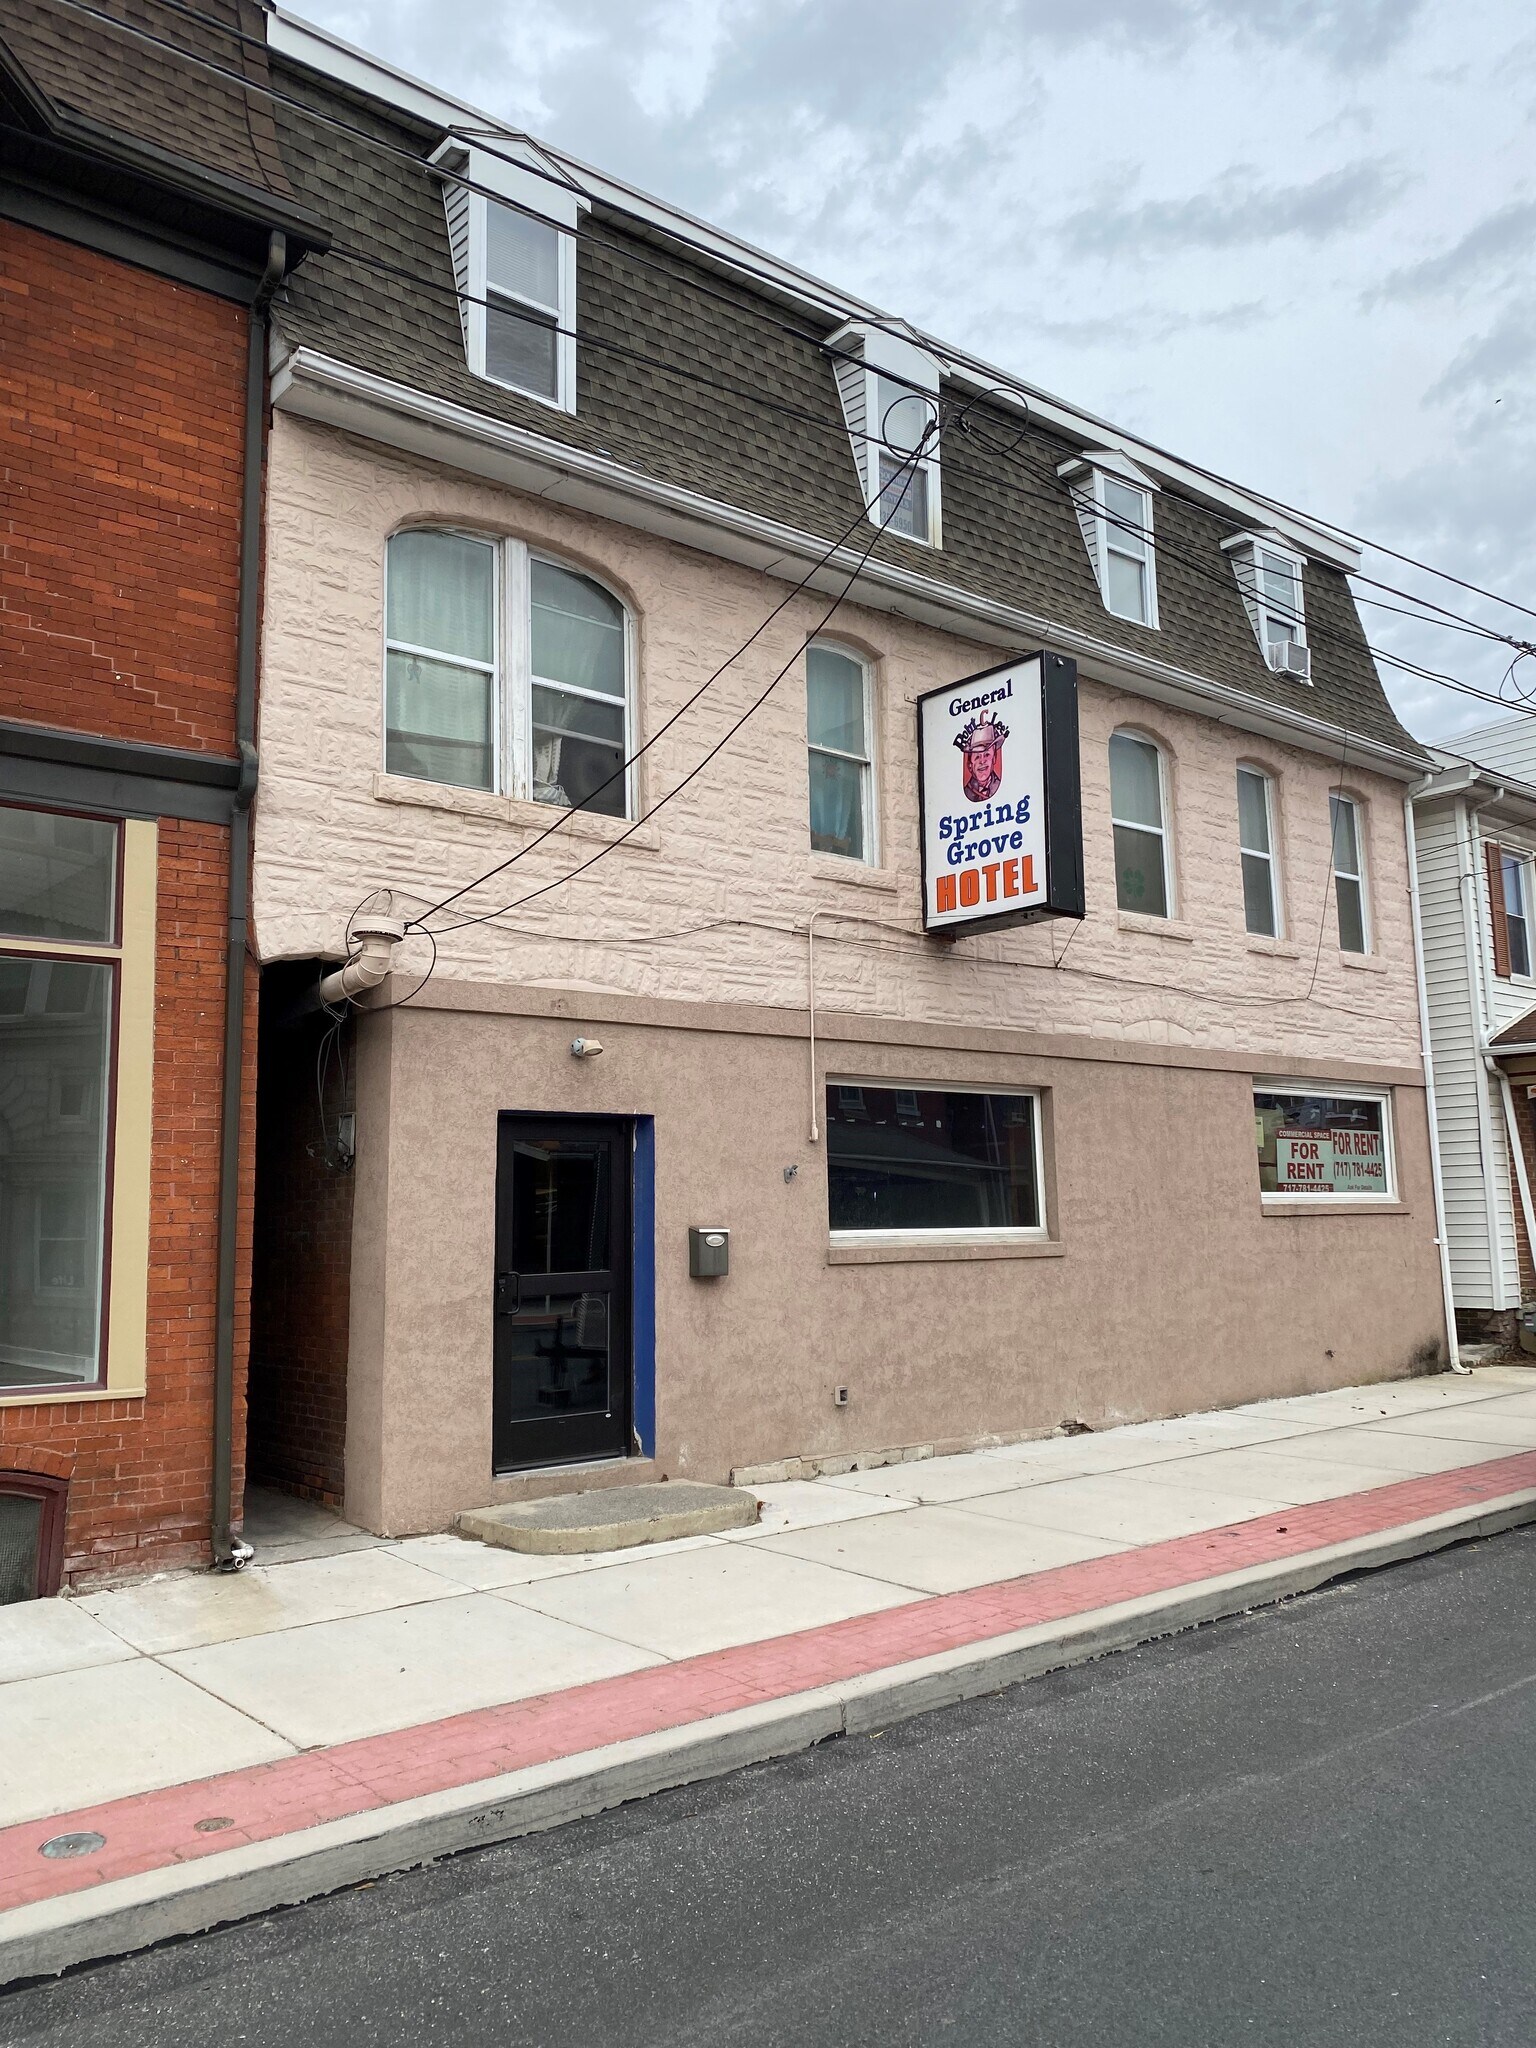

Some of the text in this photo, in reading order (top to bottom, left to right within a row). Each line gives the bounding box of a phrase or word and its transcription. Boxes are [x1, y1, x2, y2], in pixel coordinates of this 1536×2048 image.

[949, 678, 1013, 716] General
[939, 795, 1030, 841] Spring
[947, 831, 1023, 865] Grove
[936, 854, 1038, 913] HOTEL
[1278, 1130, 1330, 1139] COMMERCIAL SPACE
[1332, 1131, 1379, 1156] FOR RENT
[1291, 1142, 1319, 1160] FOR
[1287, 1162, 1325, 1179] RENT
[1333, 1161, 1383, 1180] (717) 781-4425
[1283, 1184, 1330, 1192] 717-781-4425
